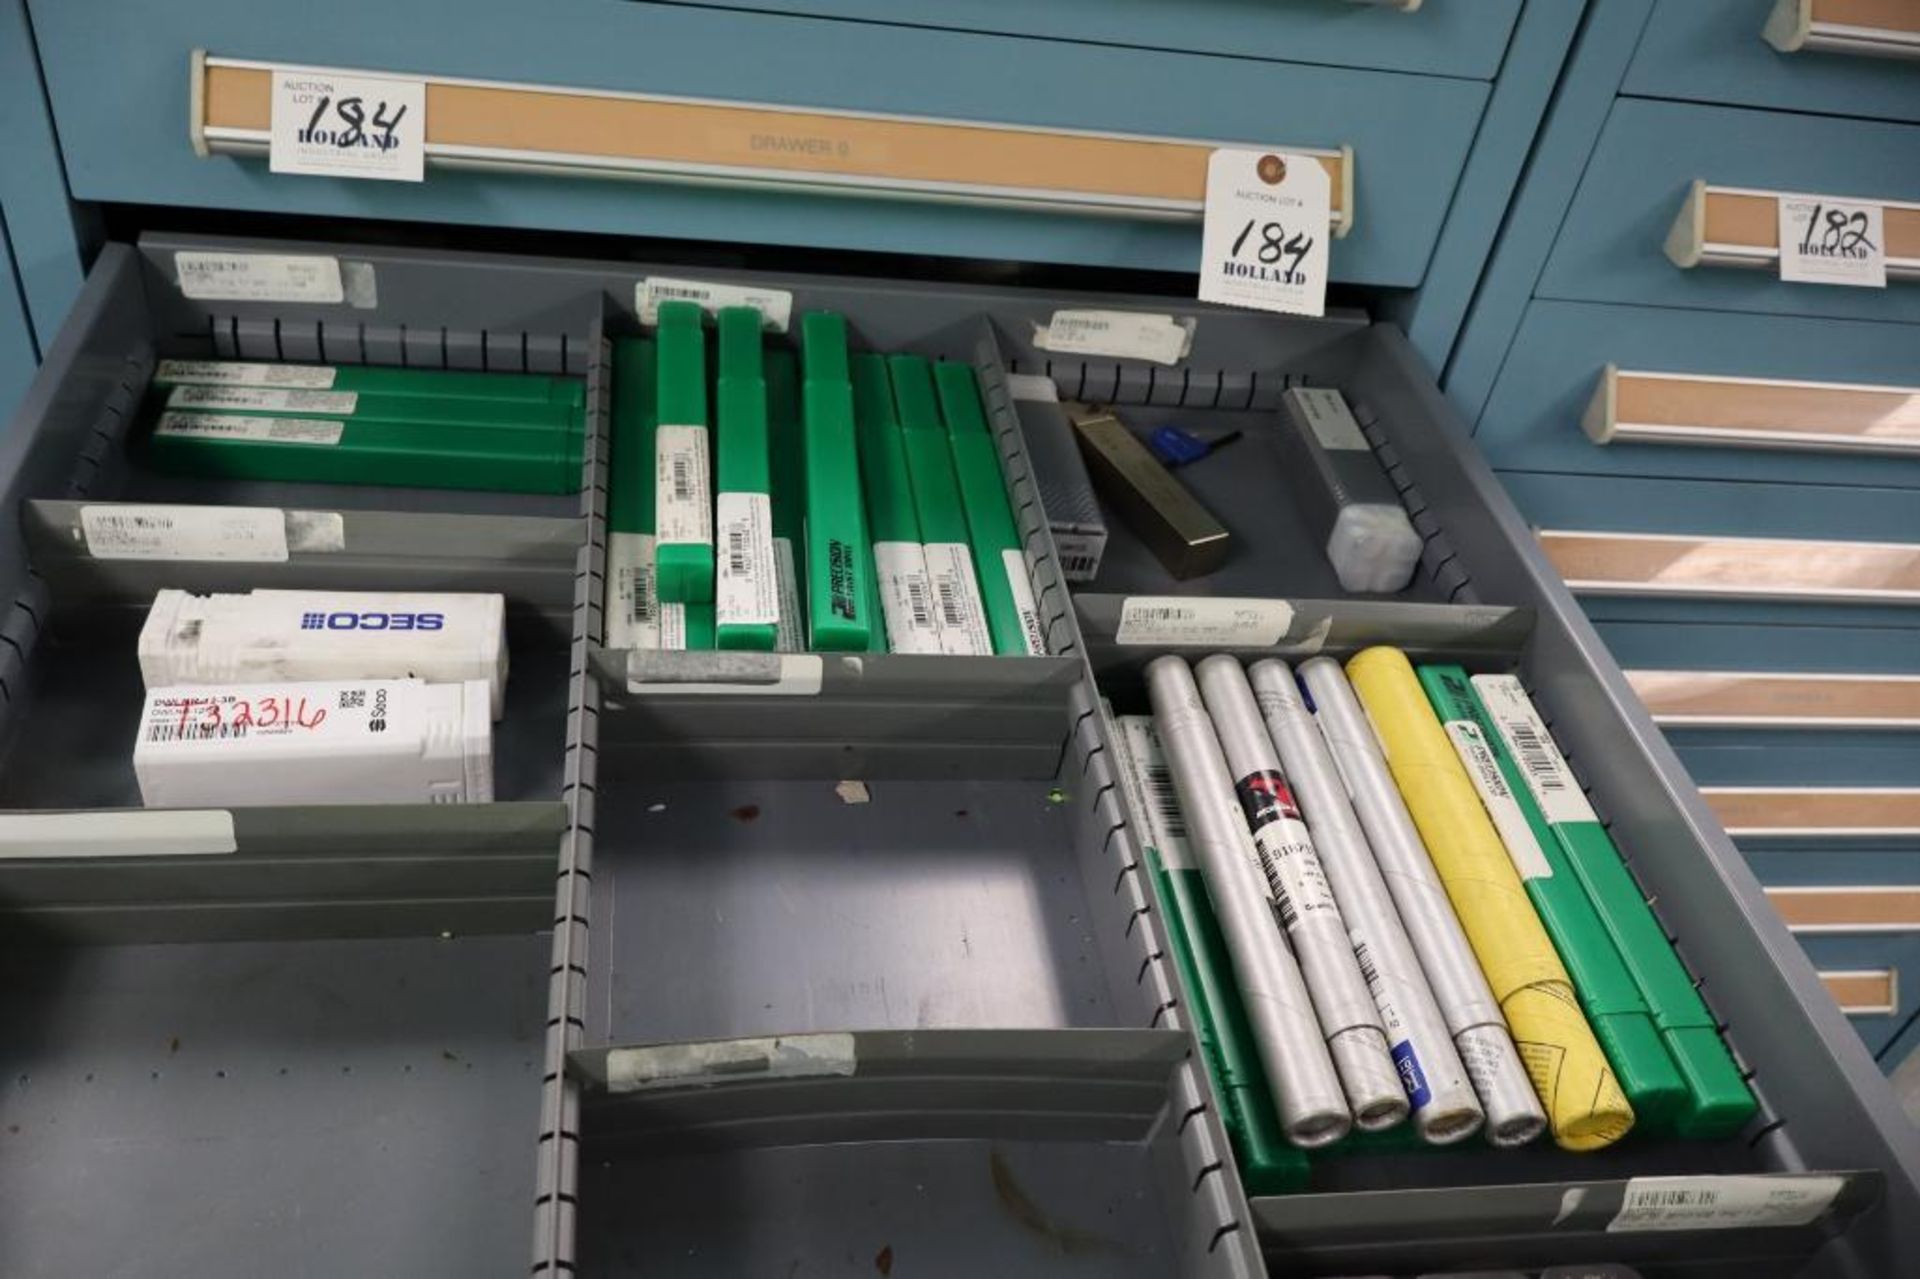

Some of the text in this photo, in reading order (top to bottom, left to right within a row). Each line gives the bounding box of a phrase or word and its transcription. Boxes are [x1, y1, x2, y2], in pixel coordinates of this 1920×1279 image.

[284, 80, 334, 92] AUCTION
[293, 94, 315, 104] LOT
[308, 96, 407, 153] 184
[750, 134, 832, 155] DRAWER
[1804, 203, 1877, 253] 182
[1231, 219, 1313, 284] 184
[1223, 261, 1307, 286] HOLLAND
[829, 539, 844, 595] PRECISION
[327, 612, 445, 630] SECO
[370, 688, 387, 718] Seco
